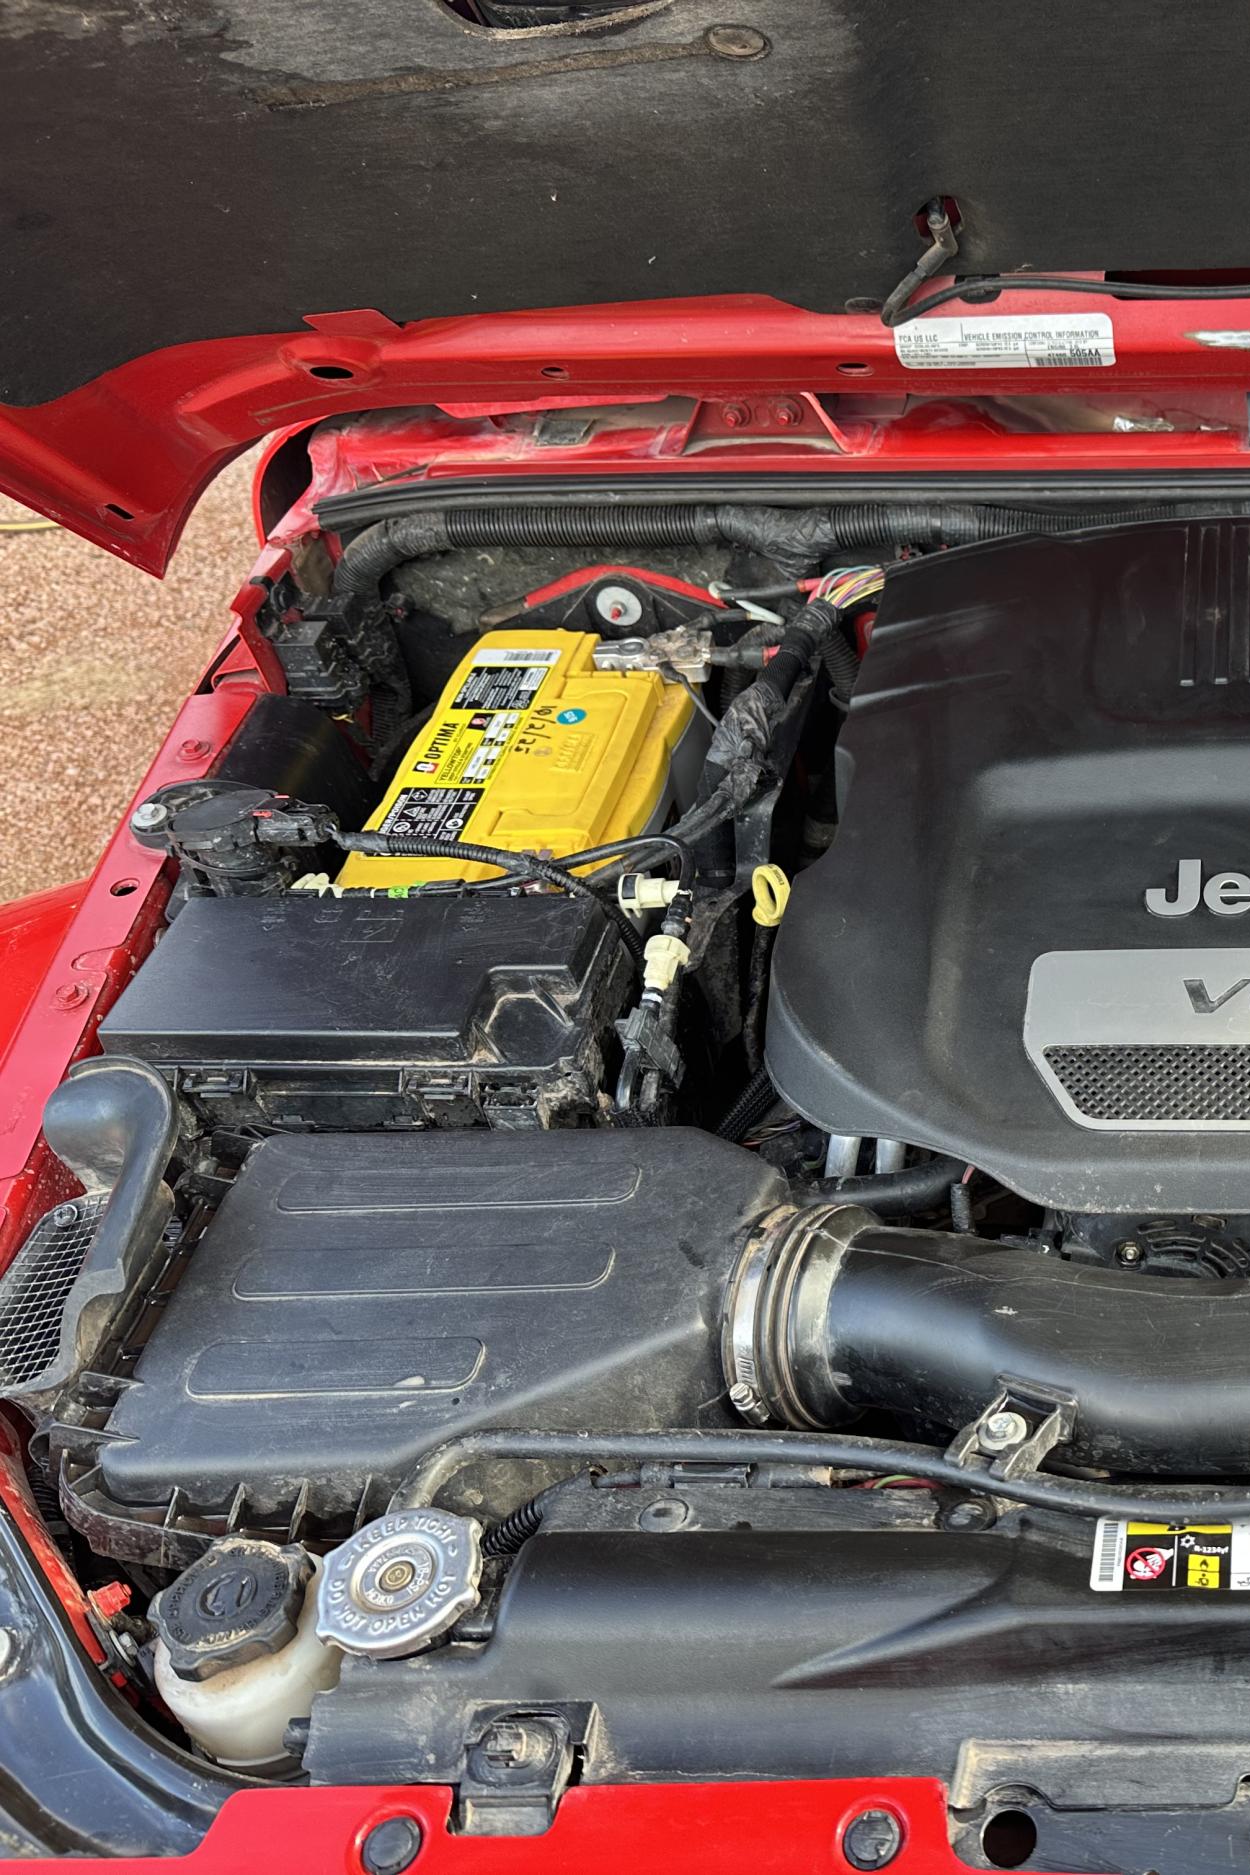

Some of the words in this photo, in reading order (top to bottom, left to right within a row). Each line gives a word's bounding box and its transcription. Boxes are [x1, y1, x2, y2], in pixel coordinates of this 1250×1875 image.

[914, 334, 924, 343] US
[925, 334, 938, 342] LLC
[964, 332, 990, 341] VEHICLE
[991, 332, 1022, 341] EMISSION
[1024, 331, 1053, 340] CONTROL
[1055, 330, 1100, 339] INFORMATION
[1069, 348, 1101, 358] 505AA
[423, 721, 459, 760] OPTIMA
[353, 1518, 409, 1552] KEEP
[413, 1516, 457, 1544] TIGHT
[329, 1577, 345, 1604] DO
[425, 1575, 457, 1608] HOT
[333, 1604, 368, 1632] NOT
[368, 1605, 426, 1636] OPEN
